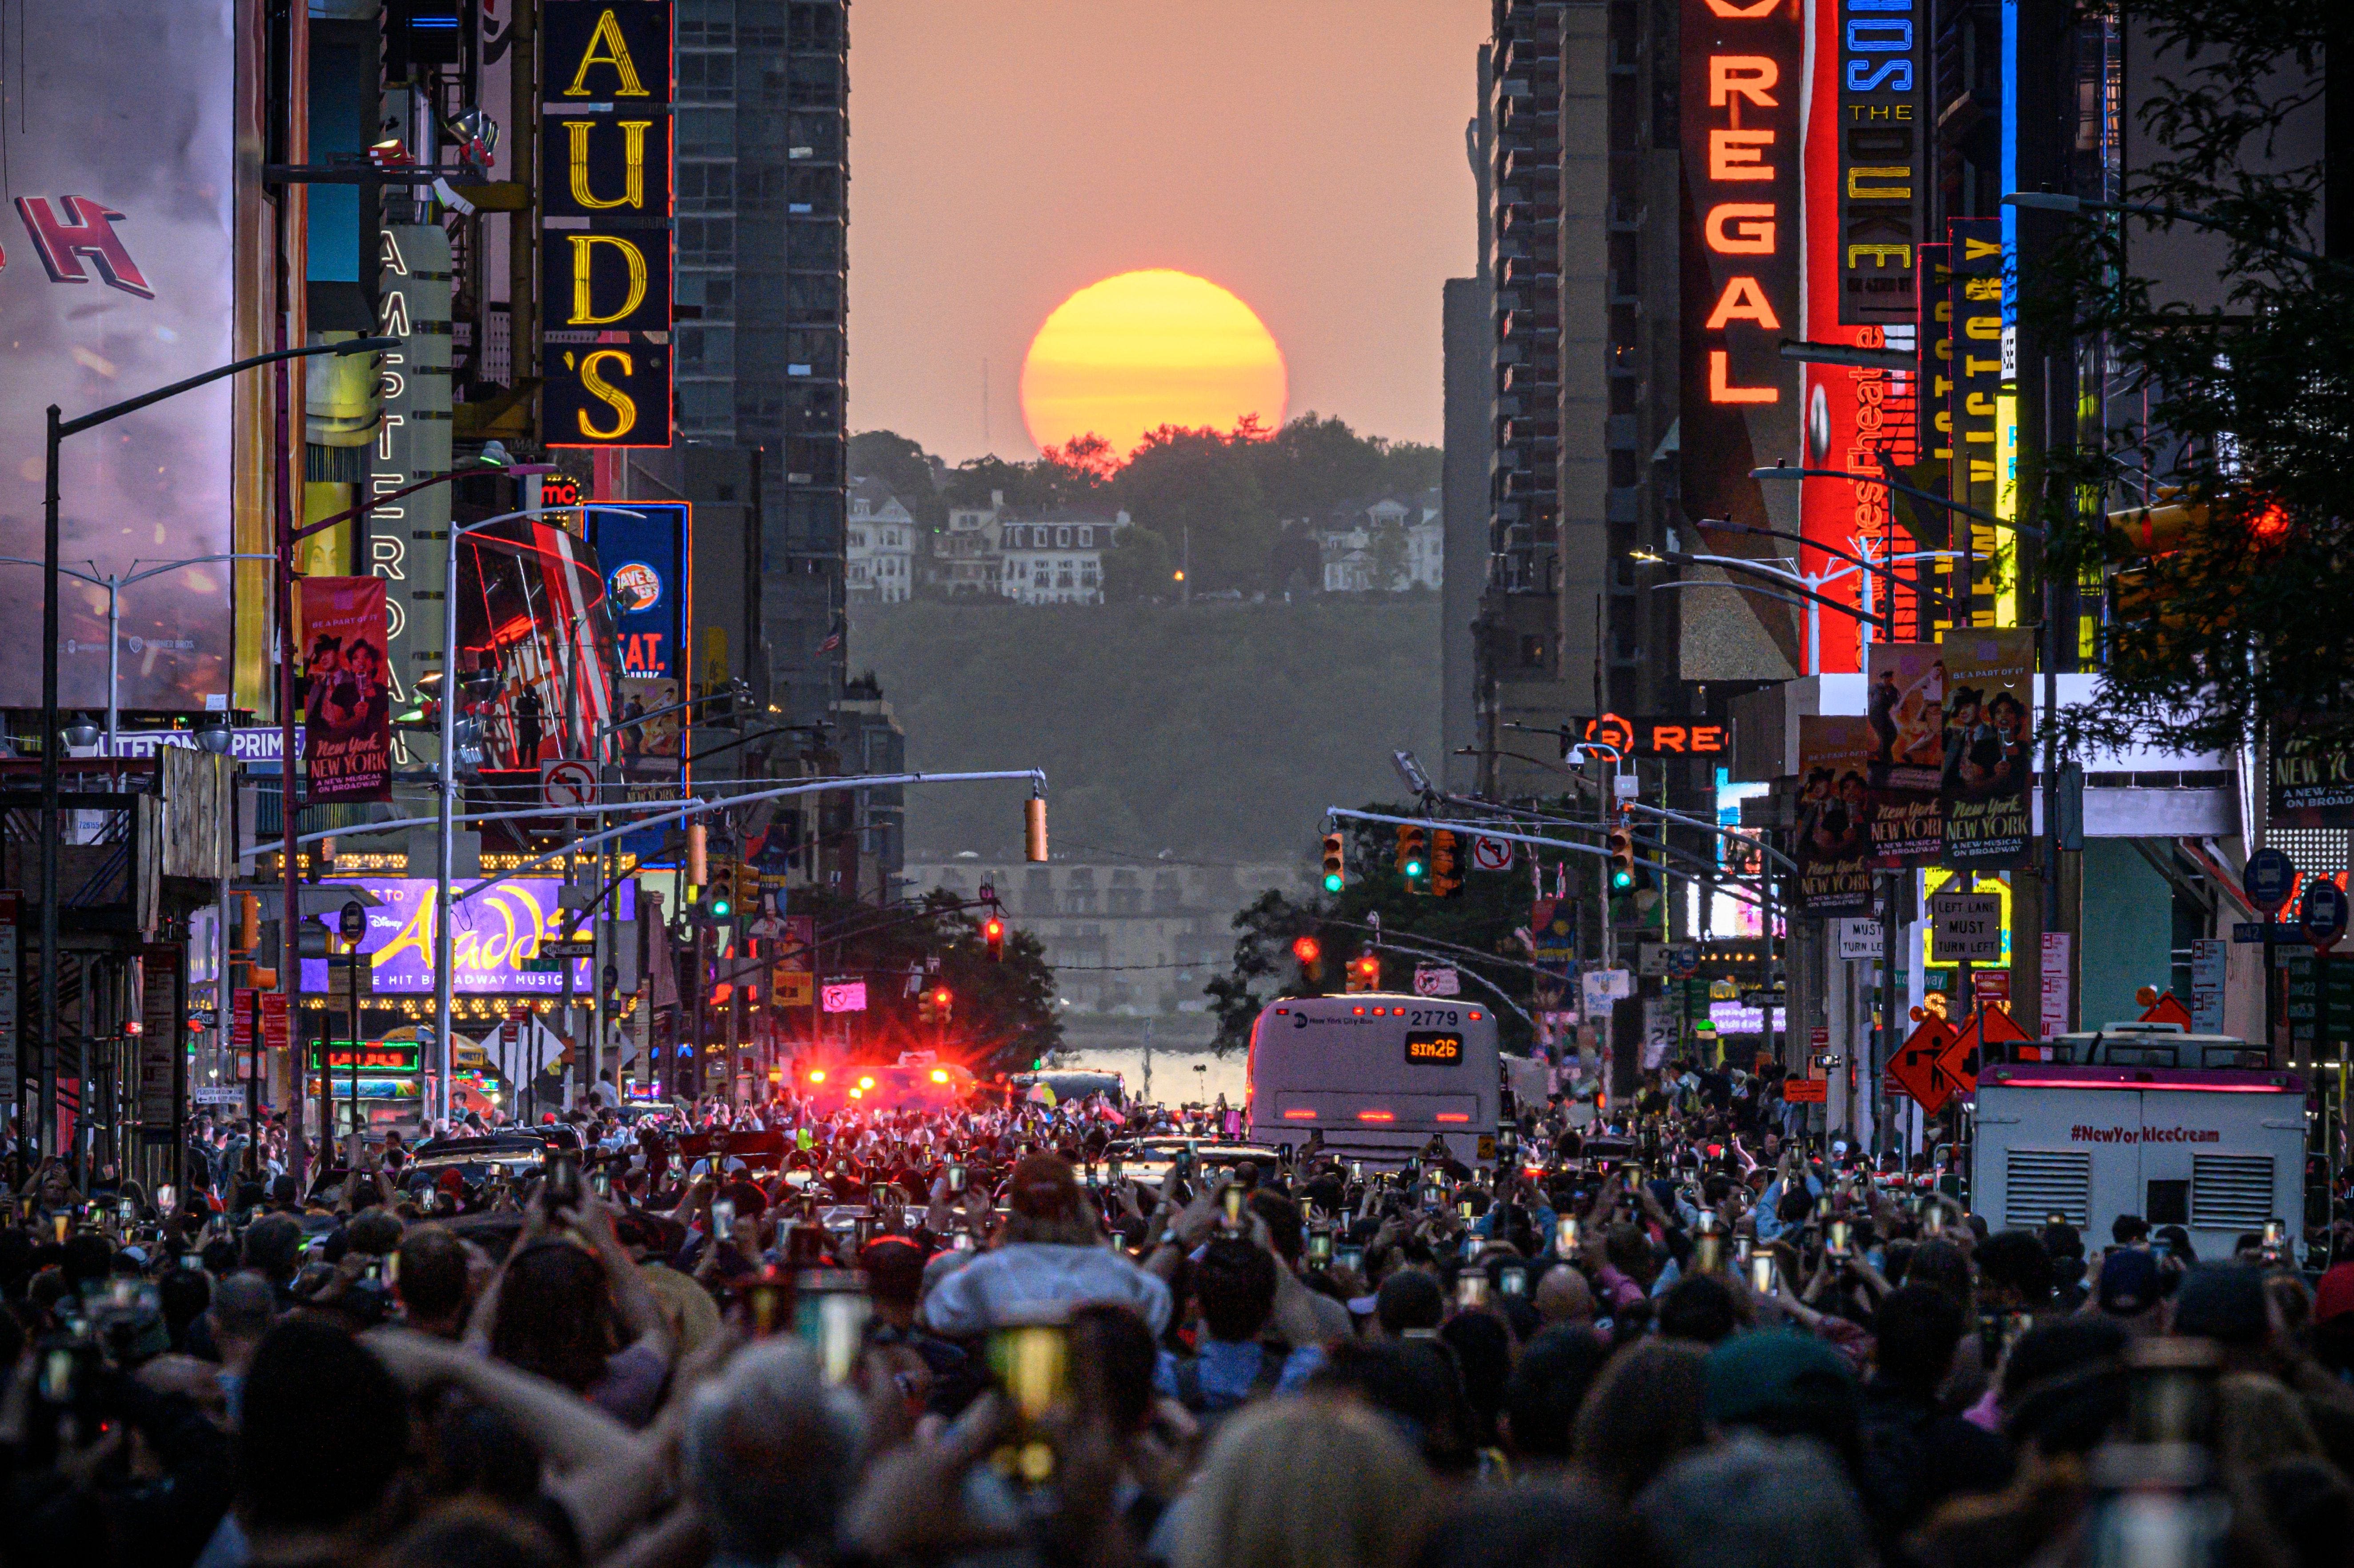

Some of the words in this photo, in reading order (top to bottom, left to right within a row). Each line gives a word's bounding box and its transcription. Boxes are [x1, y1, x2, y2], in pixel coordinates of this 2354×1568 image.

[1849, 105, 1912, 120] THE
[1847, 128, 1913, 269] DUKE
[1706, 55, 1780, 403] REGAL
[0, 196, 155, 300] H
[1934, 260, 1953, 458] ICTORY
[1847, 325, 1884, 483] Theate
[541, 484, 576, 504] mc
[333, 618, 355, 626] PART
[618, 633, 665, 670] AT.
[233, 733, 301, 757] PRIME
[1653, 726, 1729, 752] RE
[316, 740, 346, 757] New
[311, 756, 340, 778] NEW
[344, 751, 388, 774] YORK
[2276, 756, 2318, 786] NEW
[332, 780, 381, 791] BROADWAY
[345, 773, 382, 783] MUSICAL
[2283, 789, 2293, 798] A
[2295, 786, 2326, 797] NEW
[2286, 799, 2304, 808] ON
[1871, 822, 1900, 842] NEW
[1946, 820, 1977, 841] NEW
[1982, 815, 2028, 840] YORK
[1983, 838, 2023, 846] MUSICAL
[1892, 846, 1940, 855] BROADWAY
[1969, 846, 2021, 855] BROADWAY
[385, 889, 404, 901] TO
[1938, 902, 1963, 913] LEFT
[1968, 902, 1995, 912] LANE
[1853, 924, 1882, 935] MUST
[1949, 921, 1985, 934] MUST
[1844, 942, 1867, 952] TURN
[1871, 942, 1883, 951] LE
[1938, 942, 1965, 953] TURN
[1970, 941, 1995, 952] LEFT
[389, 975, 412, 985] HIT
[421, 975, 507, 985] BADWAY
[516, 975, 583, 986] MUSICL
[1343, 1018, 1357, 1026] City
[1411, 1011, 1459, 1027] 2779
[1411, 1039, 1458, 1058] SIM26
